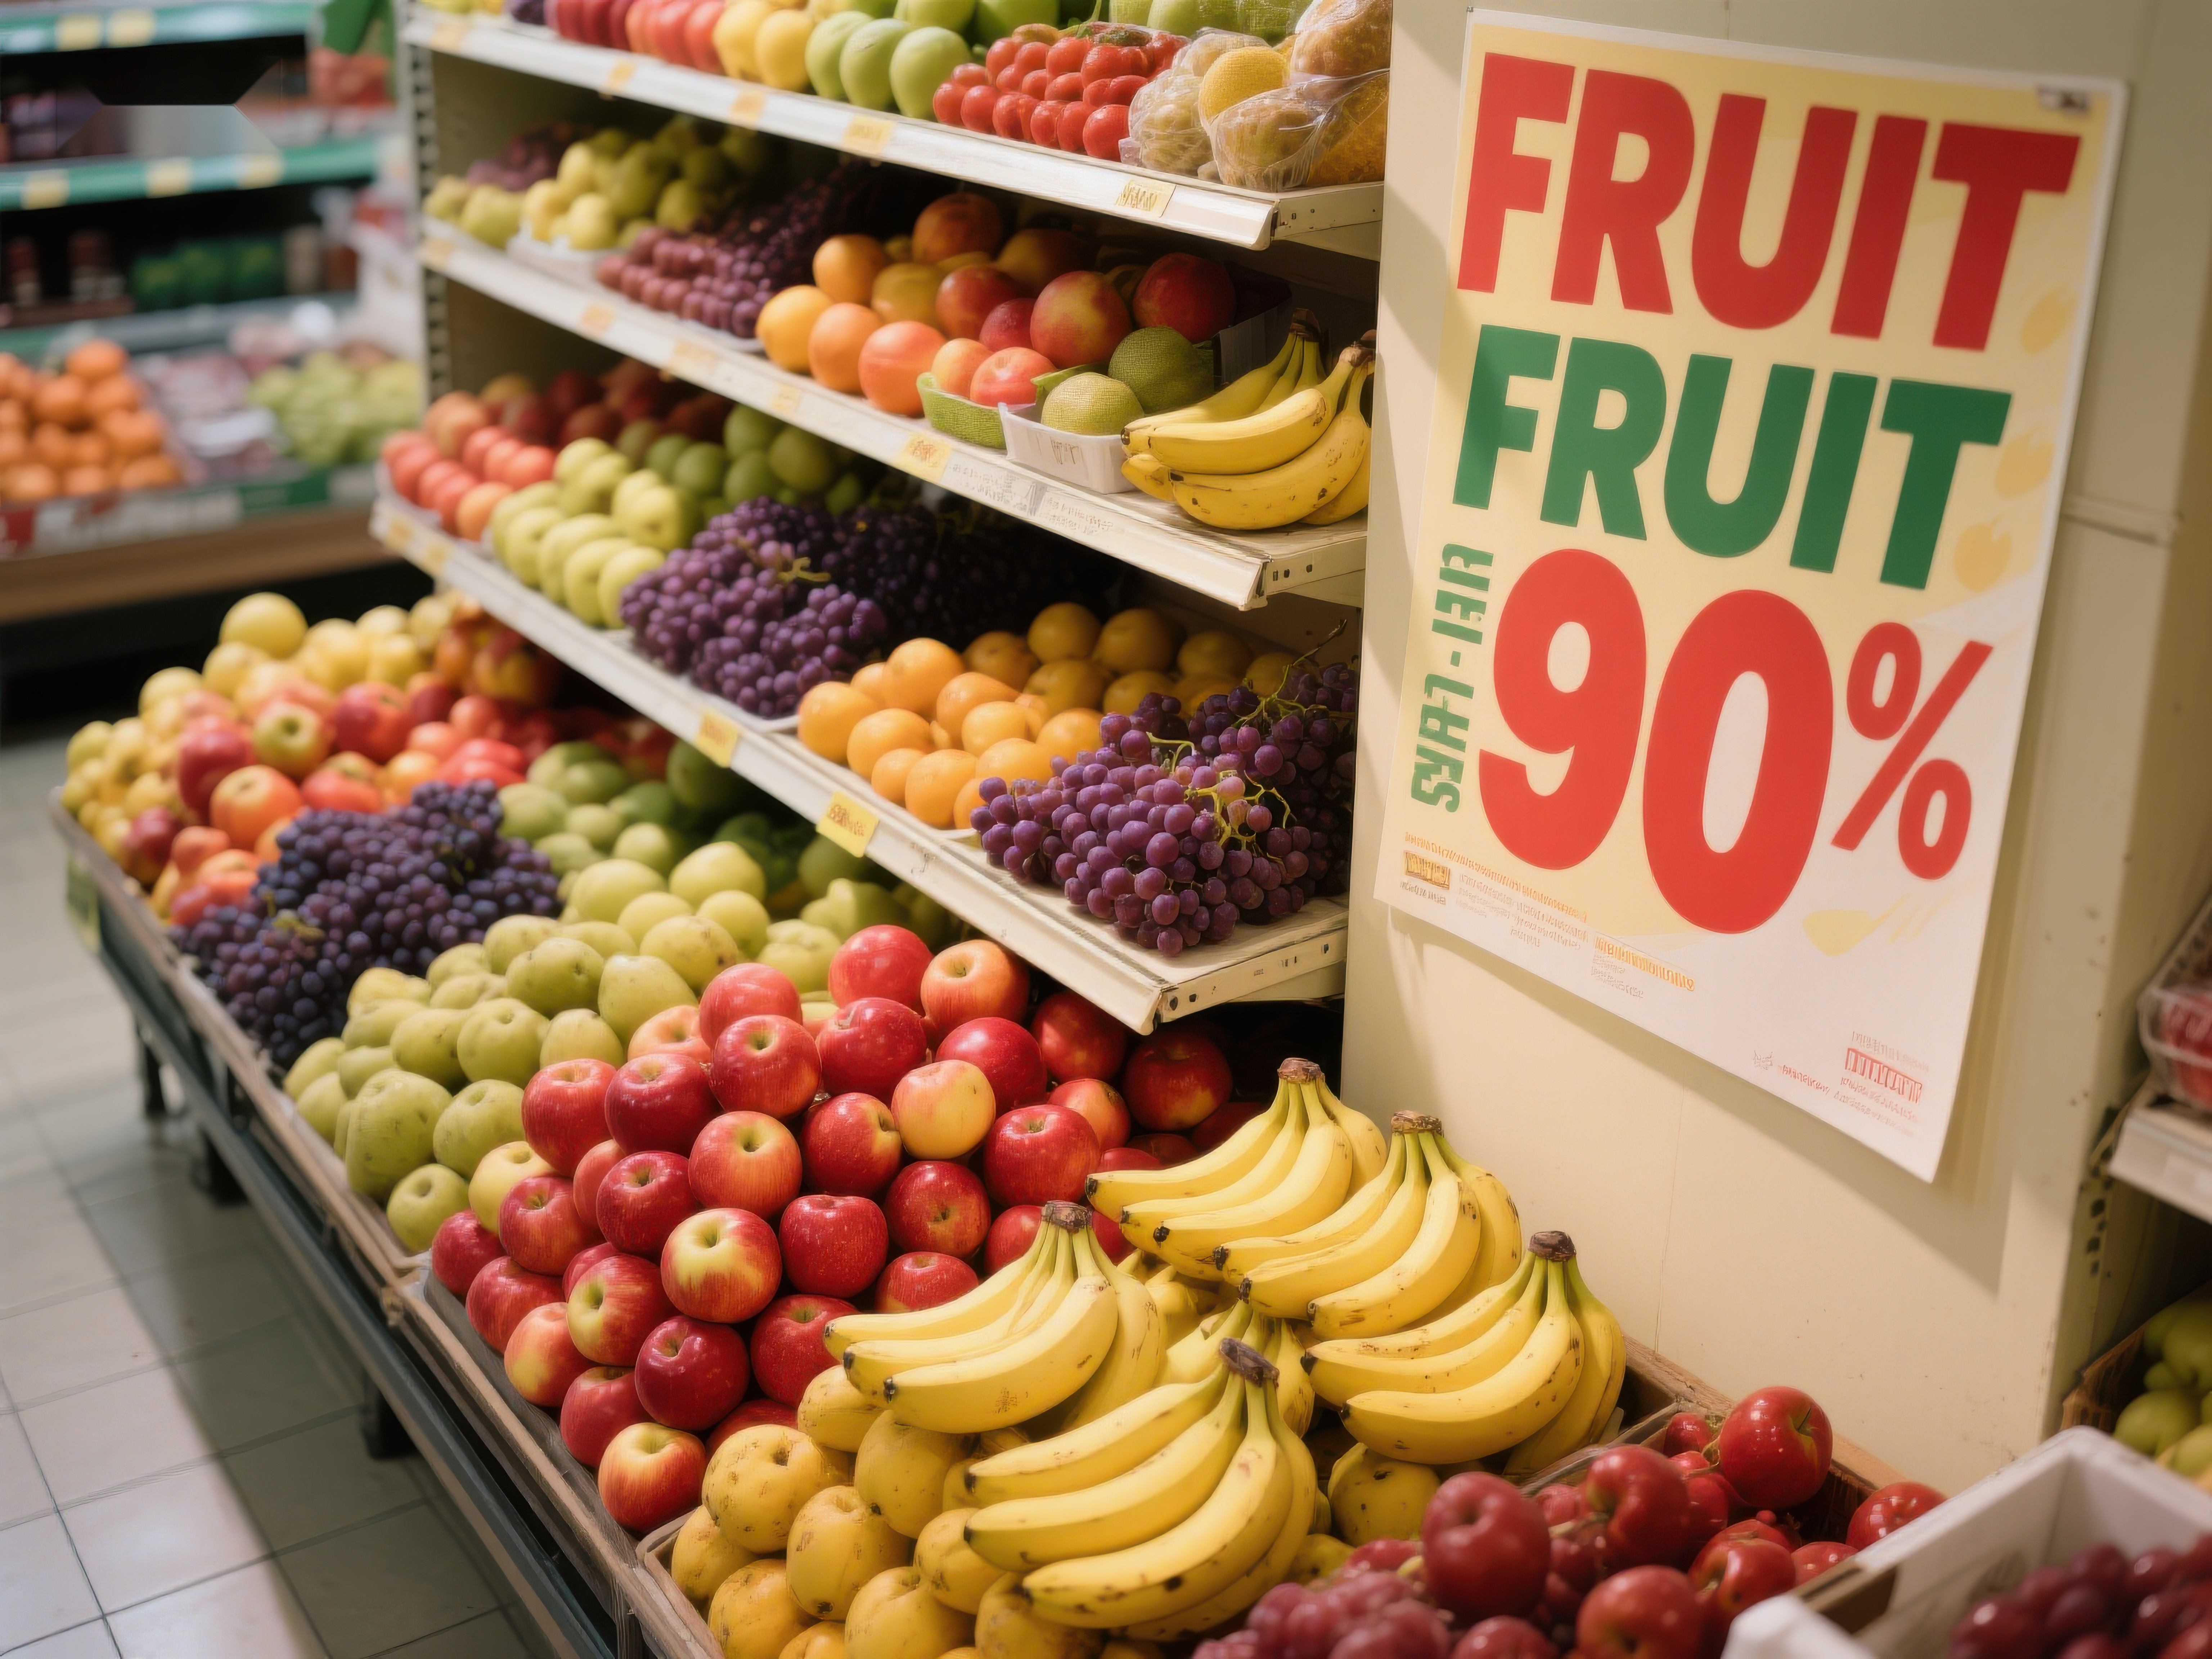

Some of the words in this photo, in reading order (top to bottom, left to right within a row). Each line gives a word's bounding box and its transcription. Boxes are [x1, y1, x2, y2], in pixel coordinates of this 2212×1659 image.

[1457, 53, 2080, 351] FRUIT
[1453, 327, 2011, 589] FRUIT
[1478, 548, 1993, 934] 90%
